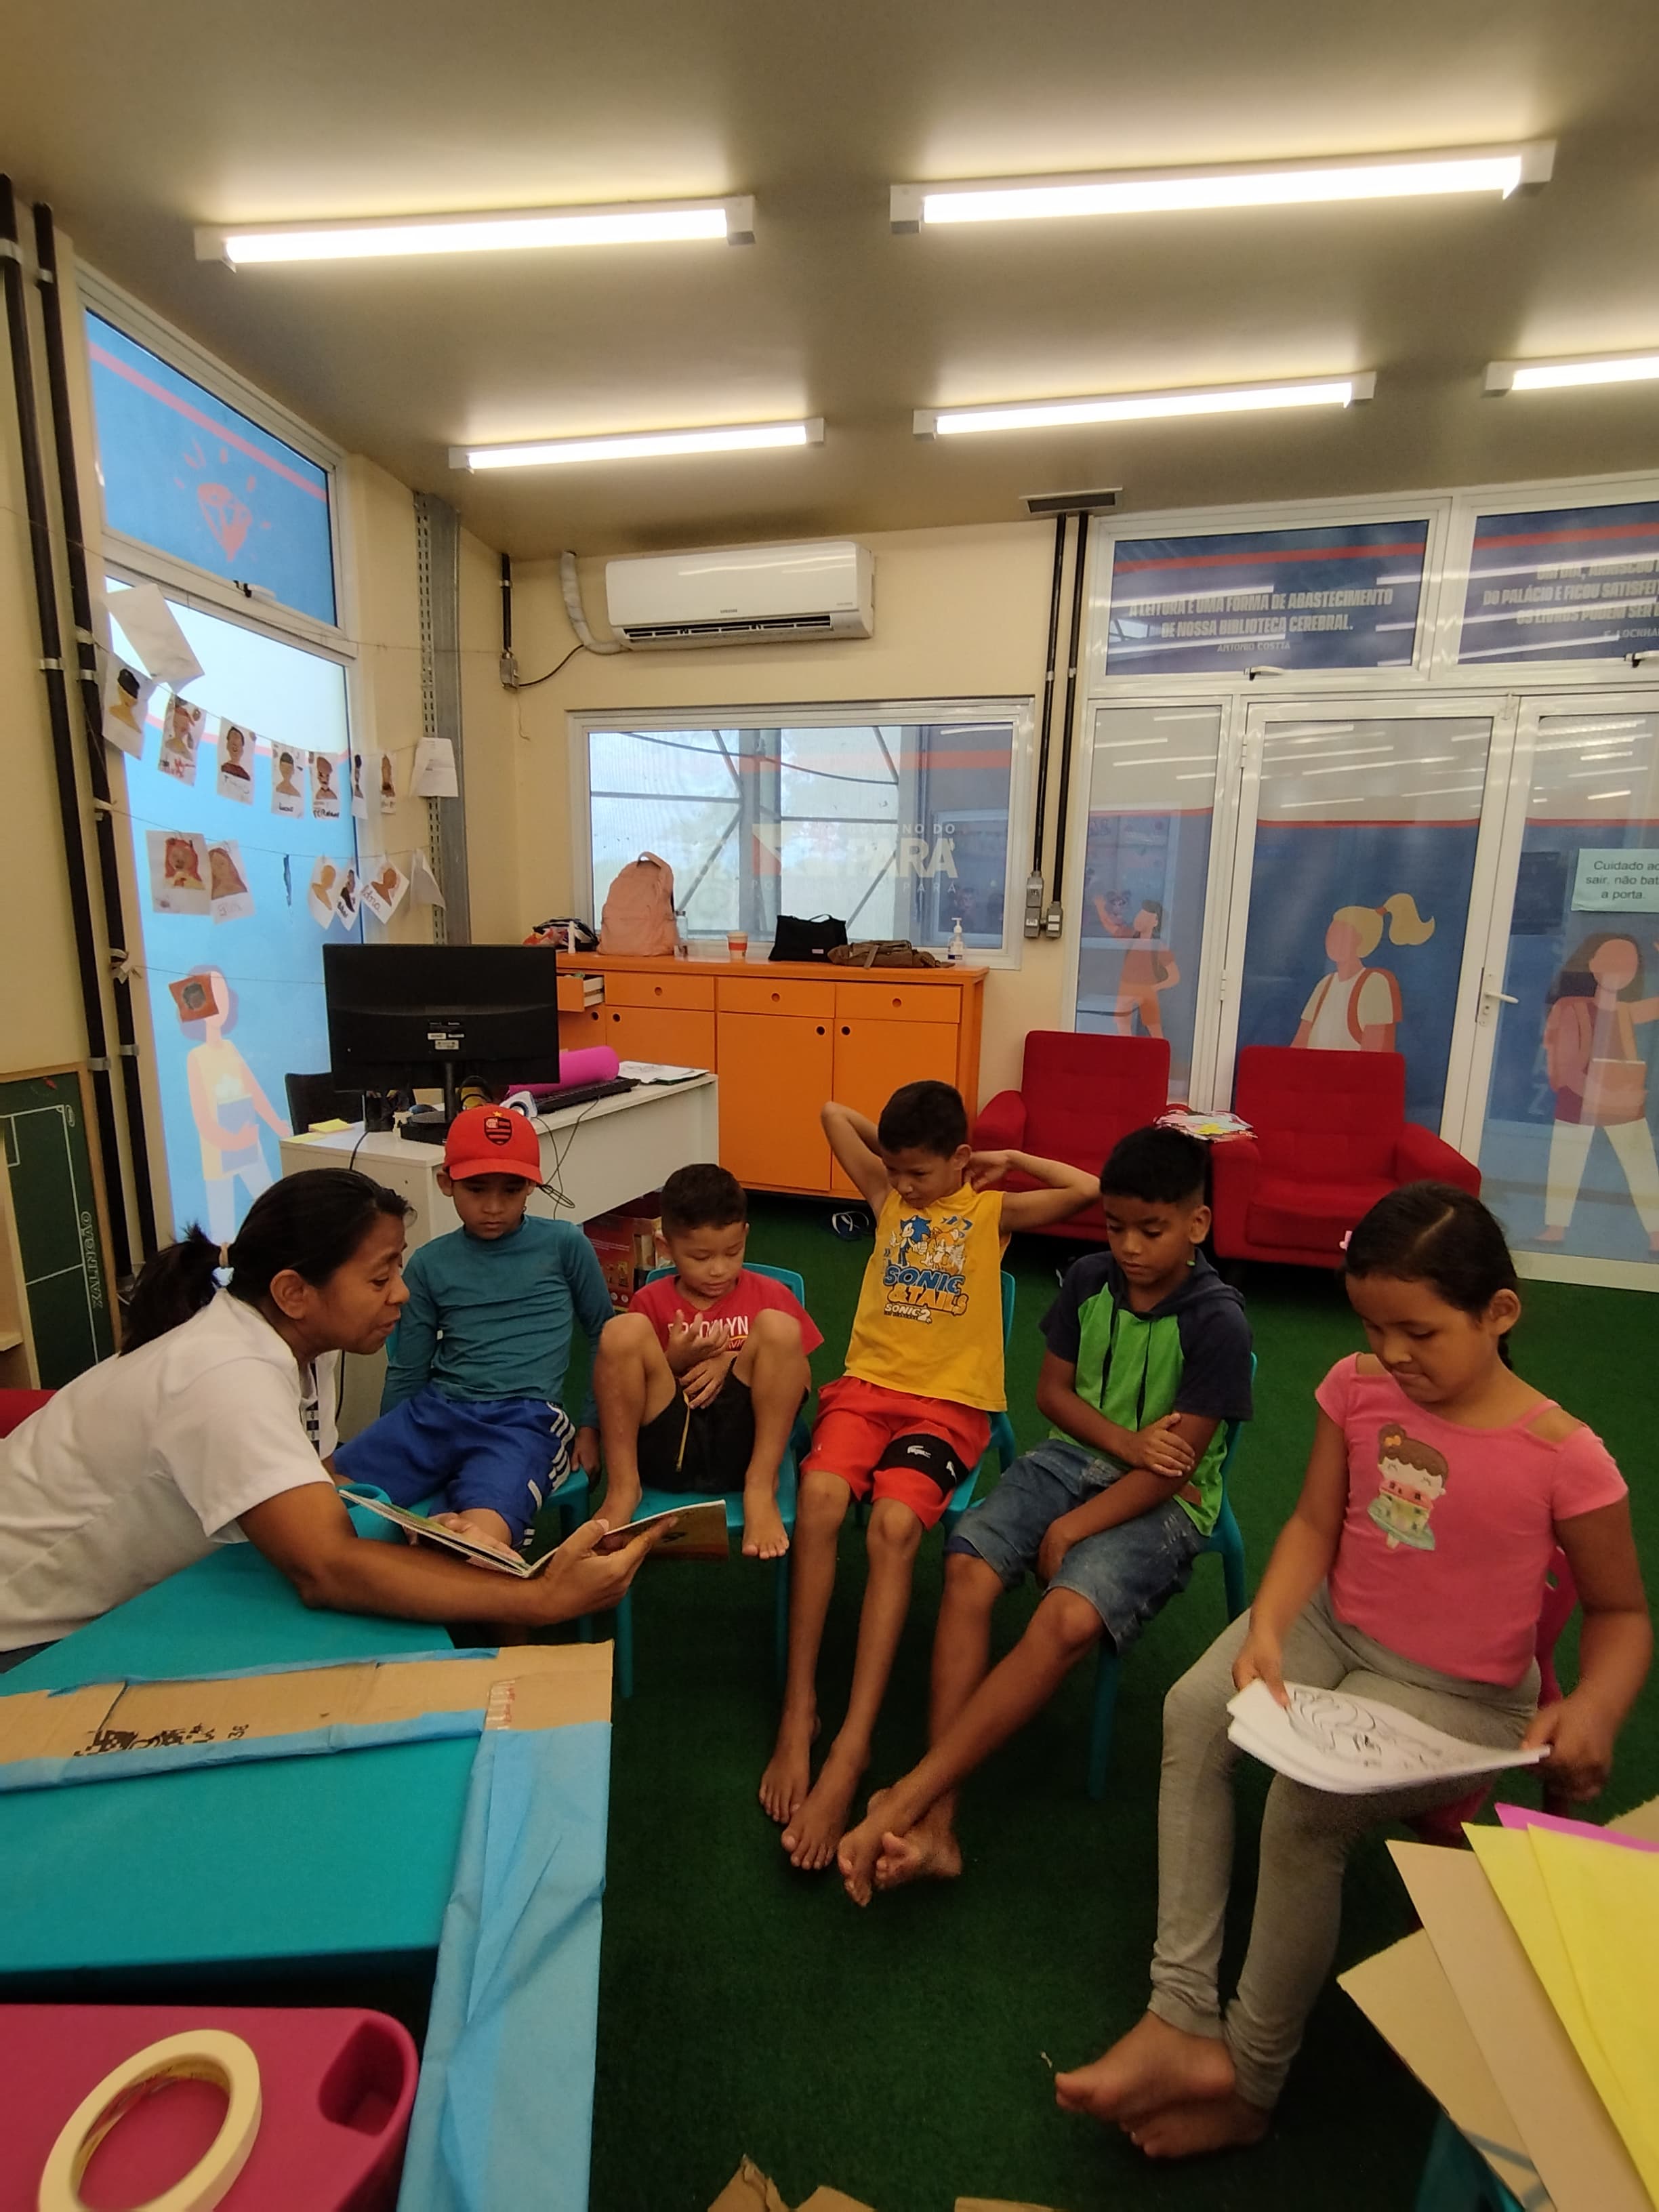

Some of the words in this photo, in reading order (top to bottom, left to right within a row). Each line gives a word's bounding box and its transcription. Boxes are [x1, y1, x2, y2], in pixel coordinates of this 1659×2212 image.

[1139, 598, 1186, 617] LEITURA
[1195, 594, 1225, 613] UMA
[1225, 593, 1270, 612] FORMA
[1271, 592, 1287, 610] DE
[1288, 588, 1394, 609] ABASTECIMENTO
[1483, 590, 1500, 605] DO
[1501, 585, 1553, 605] PALÁCIO
[1554, 588, 1563, 601] E
[1563, 583, 1601, 601] FICOU
[1628, 603, 1652, 618] SER
[1160, 621, 1176, 638] DE
[1176, 619, 1218, 638] NOSSA
[1219, 616, 1288, 635] BIBLIOTECA
[1288, 613, 1353, 632] CEREBRAL.
[933, 823, 956, 834] DO
[1594, 861, 1644, 871] Cuidado
[1614, 876, 1637, 885] não
[1601, 891, 1609, 899] a
[883, 1265, 965, 1295] SONIC
[907, 1286, 969, 1316] TAILS
